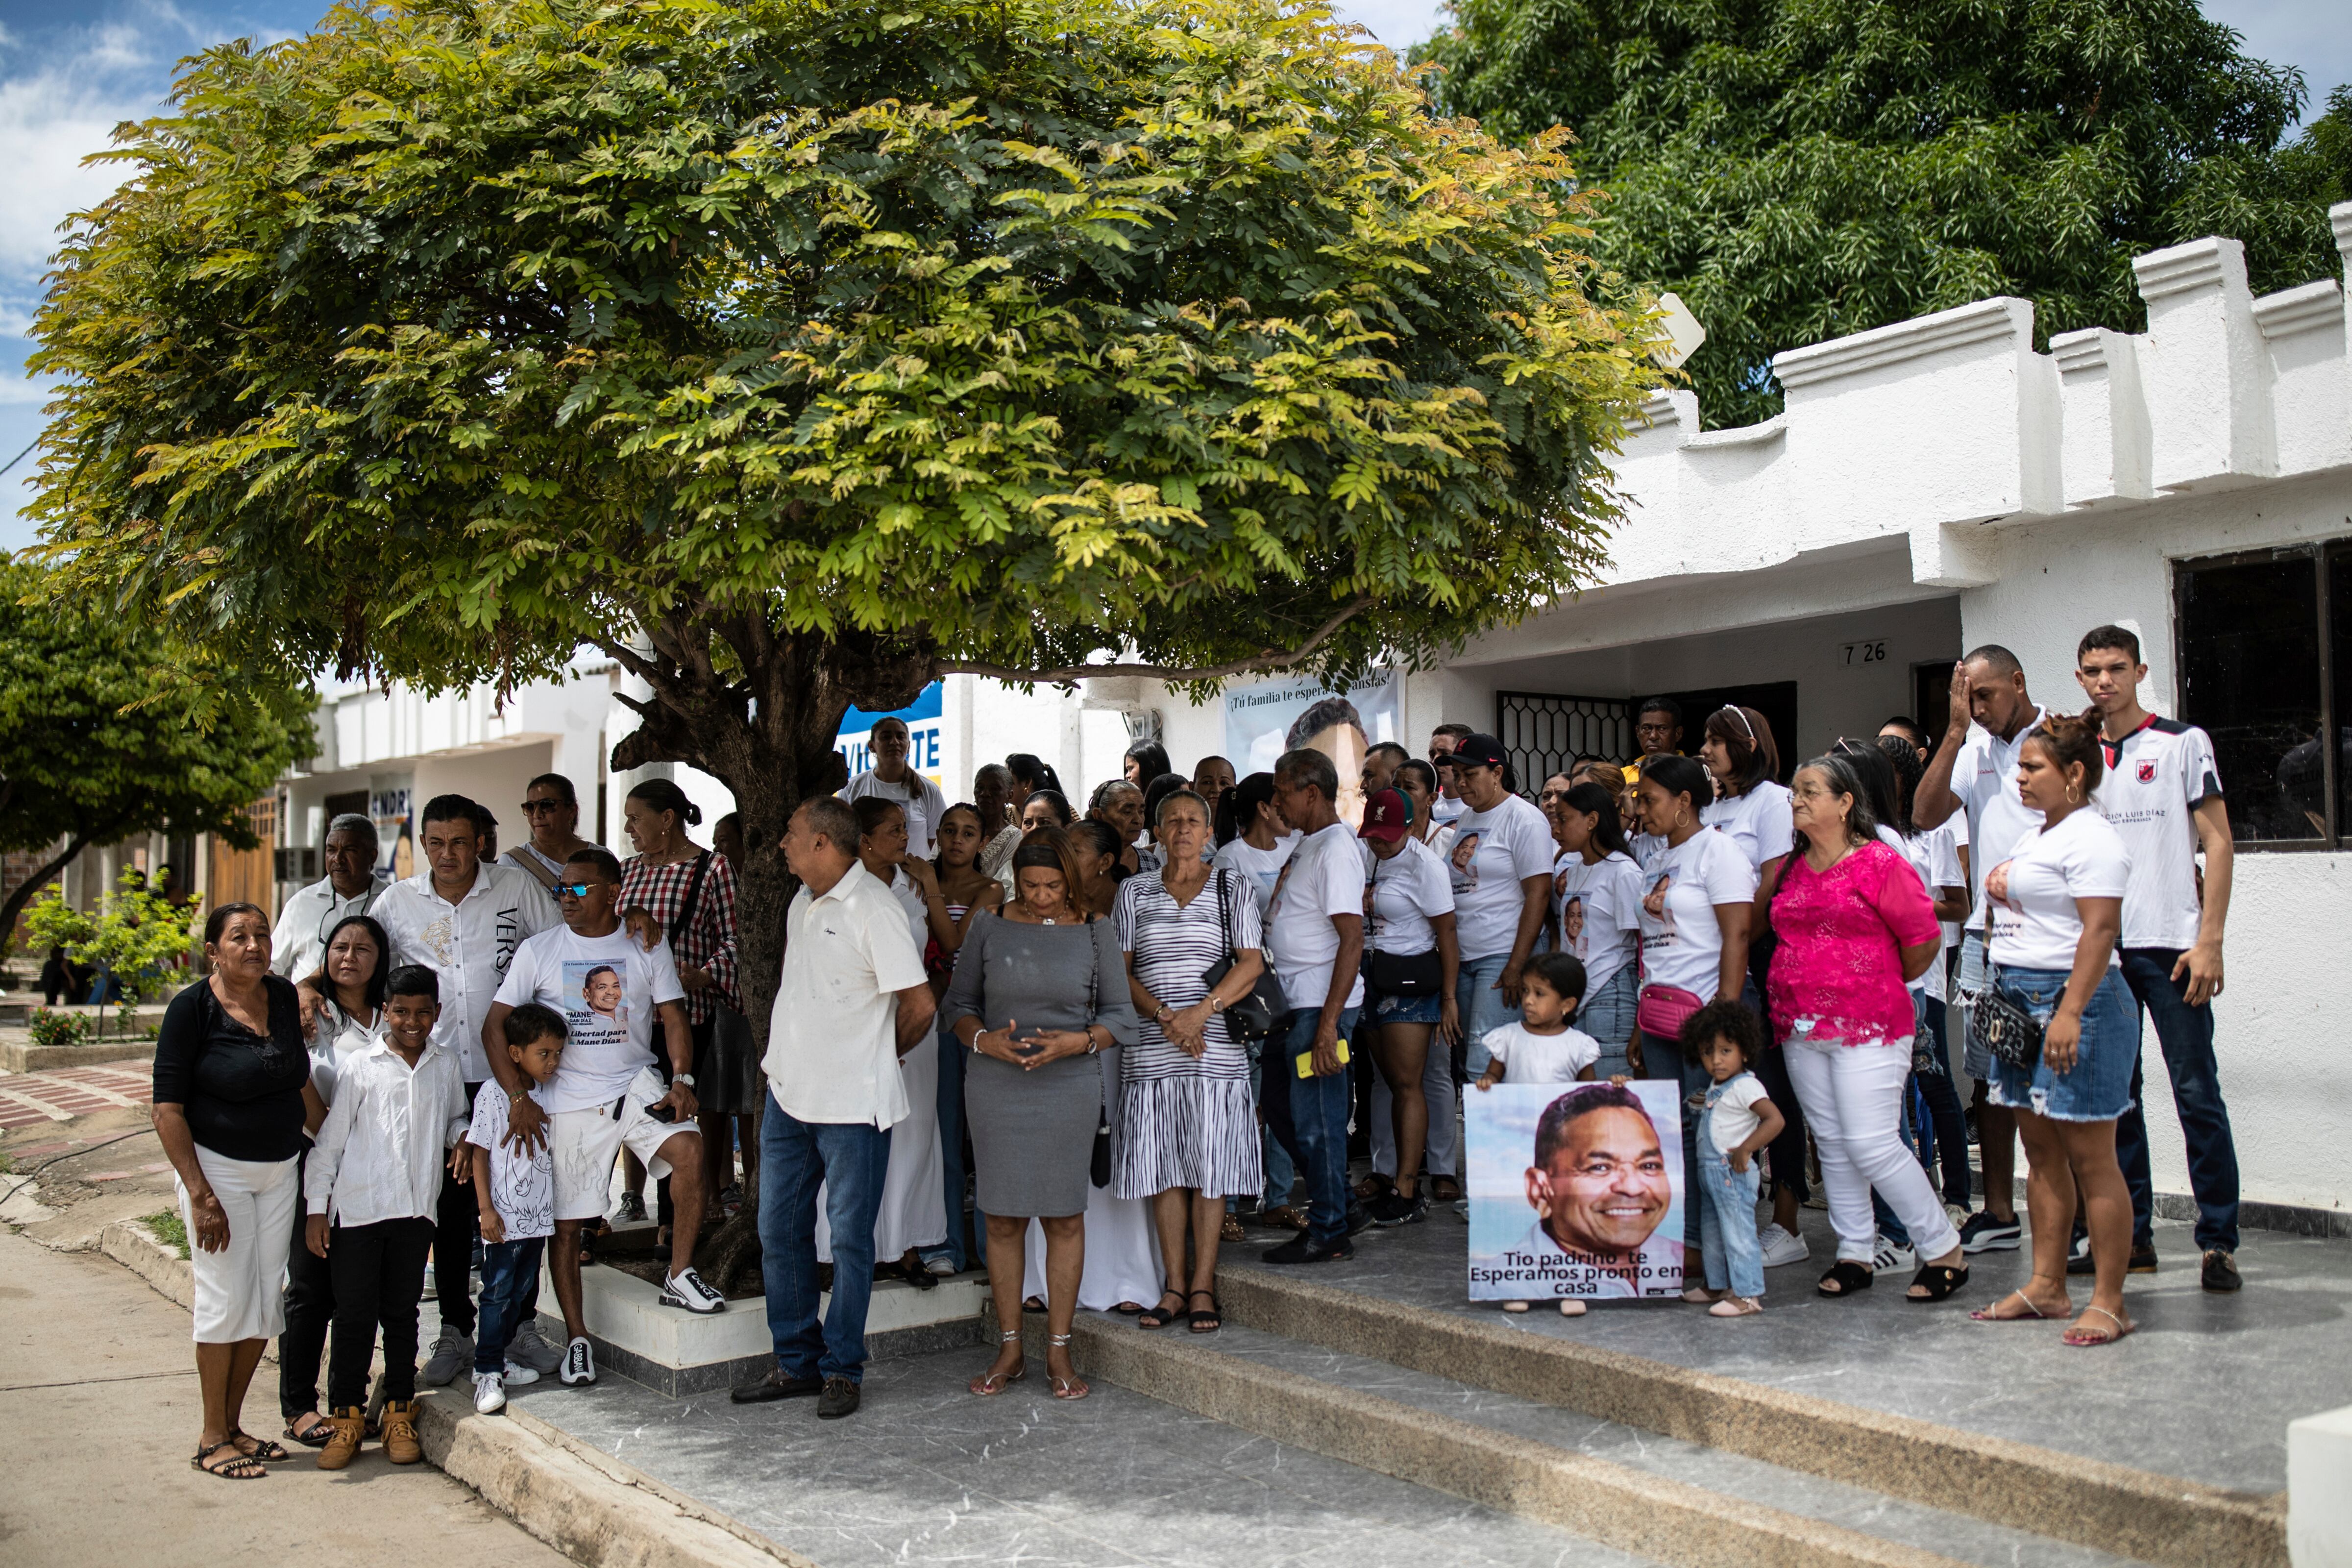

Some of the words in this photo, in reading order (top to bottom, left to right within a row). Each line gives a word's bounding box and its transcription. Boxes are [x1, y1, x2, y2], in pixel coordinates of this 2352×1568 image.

[1844, 646, 1854, 664] 7
[1864, 643, 1885, 662] 26
[1230, 694, 1245, 712] ¡Tú
[1247, 692, 1281, 708] familia
[1283, 690, 1293, 701] te
[1295, 686, 1329, 701] espera
[1504, 1251, 1534, 1267] Tio
[1540, 1250, 1617, 1270] padrino
[1627, 1250, 1647, 1265] te
[1470, 1267, 1579, 1285] Esperamos
[1585, 1266, 1652, 1283] pronto
[1658, 1265, 1683, 1278] en
[1554, 1282, 1597, 1294] casa
